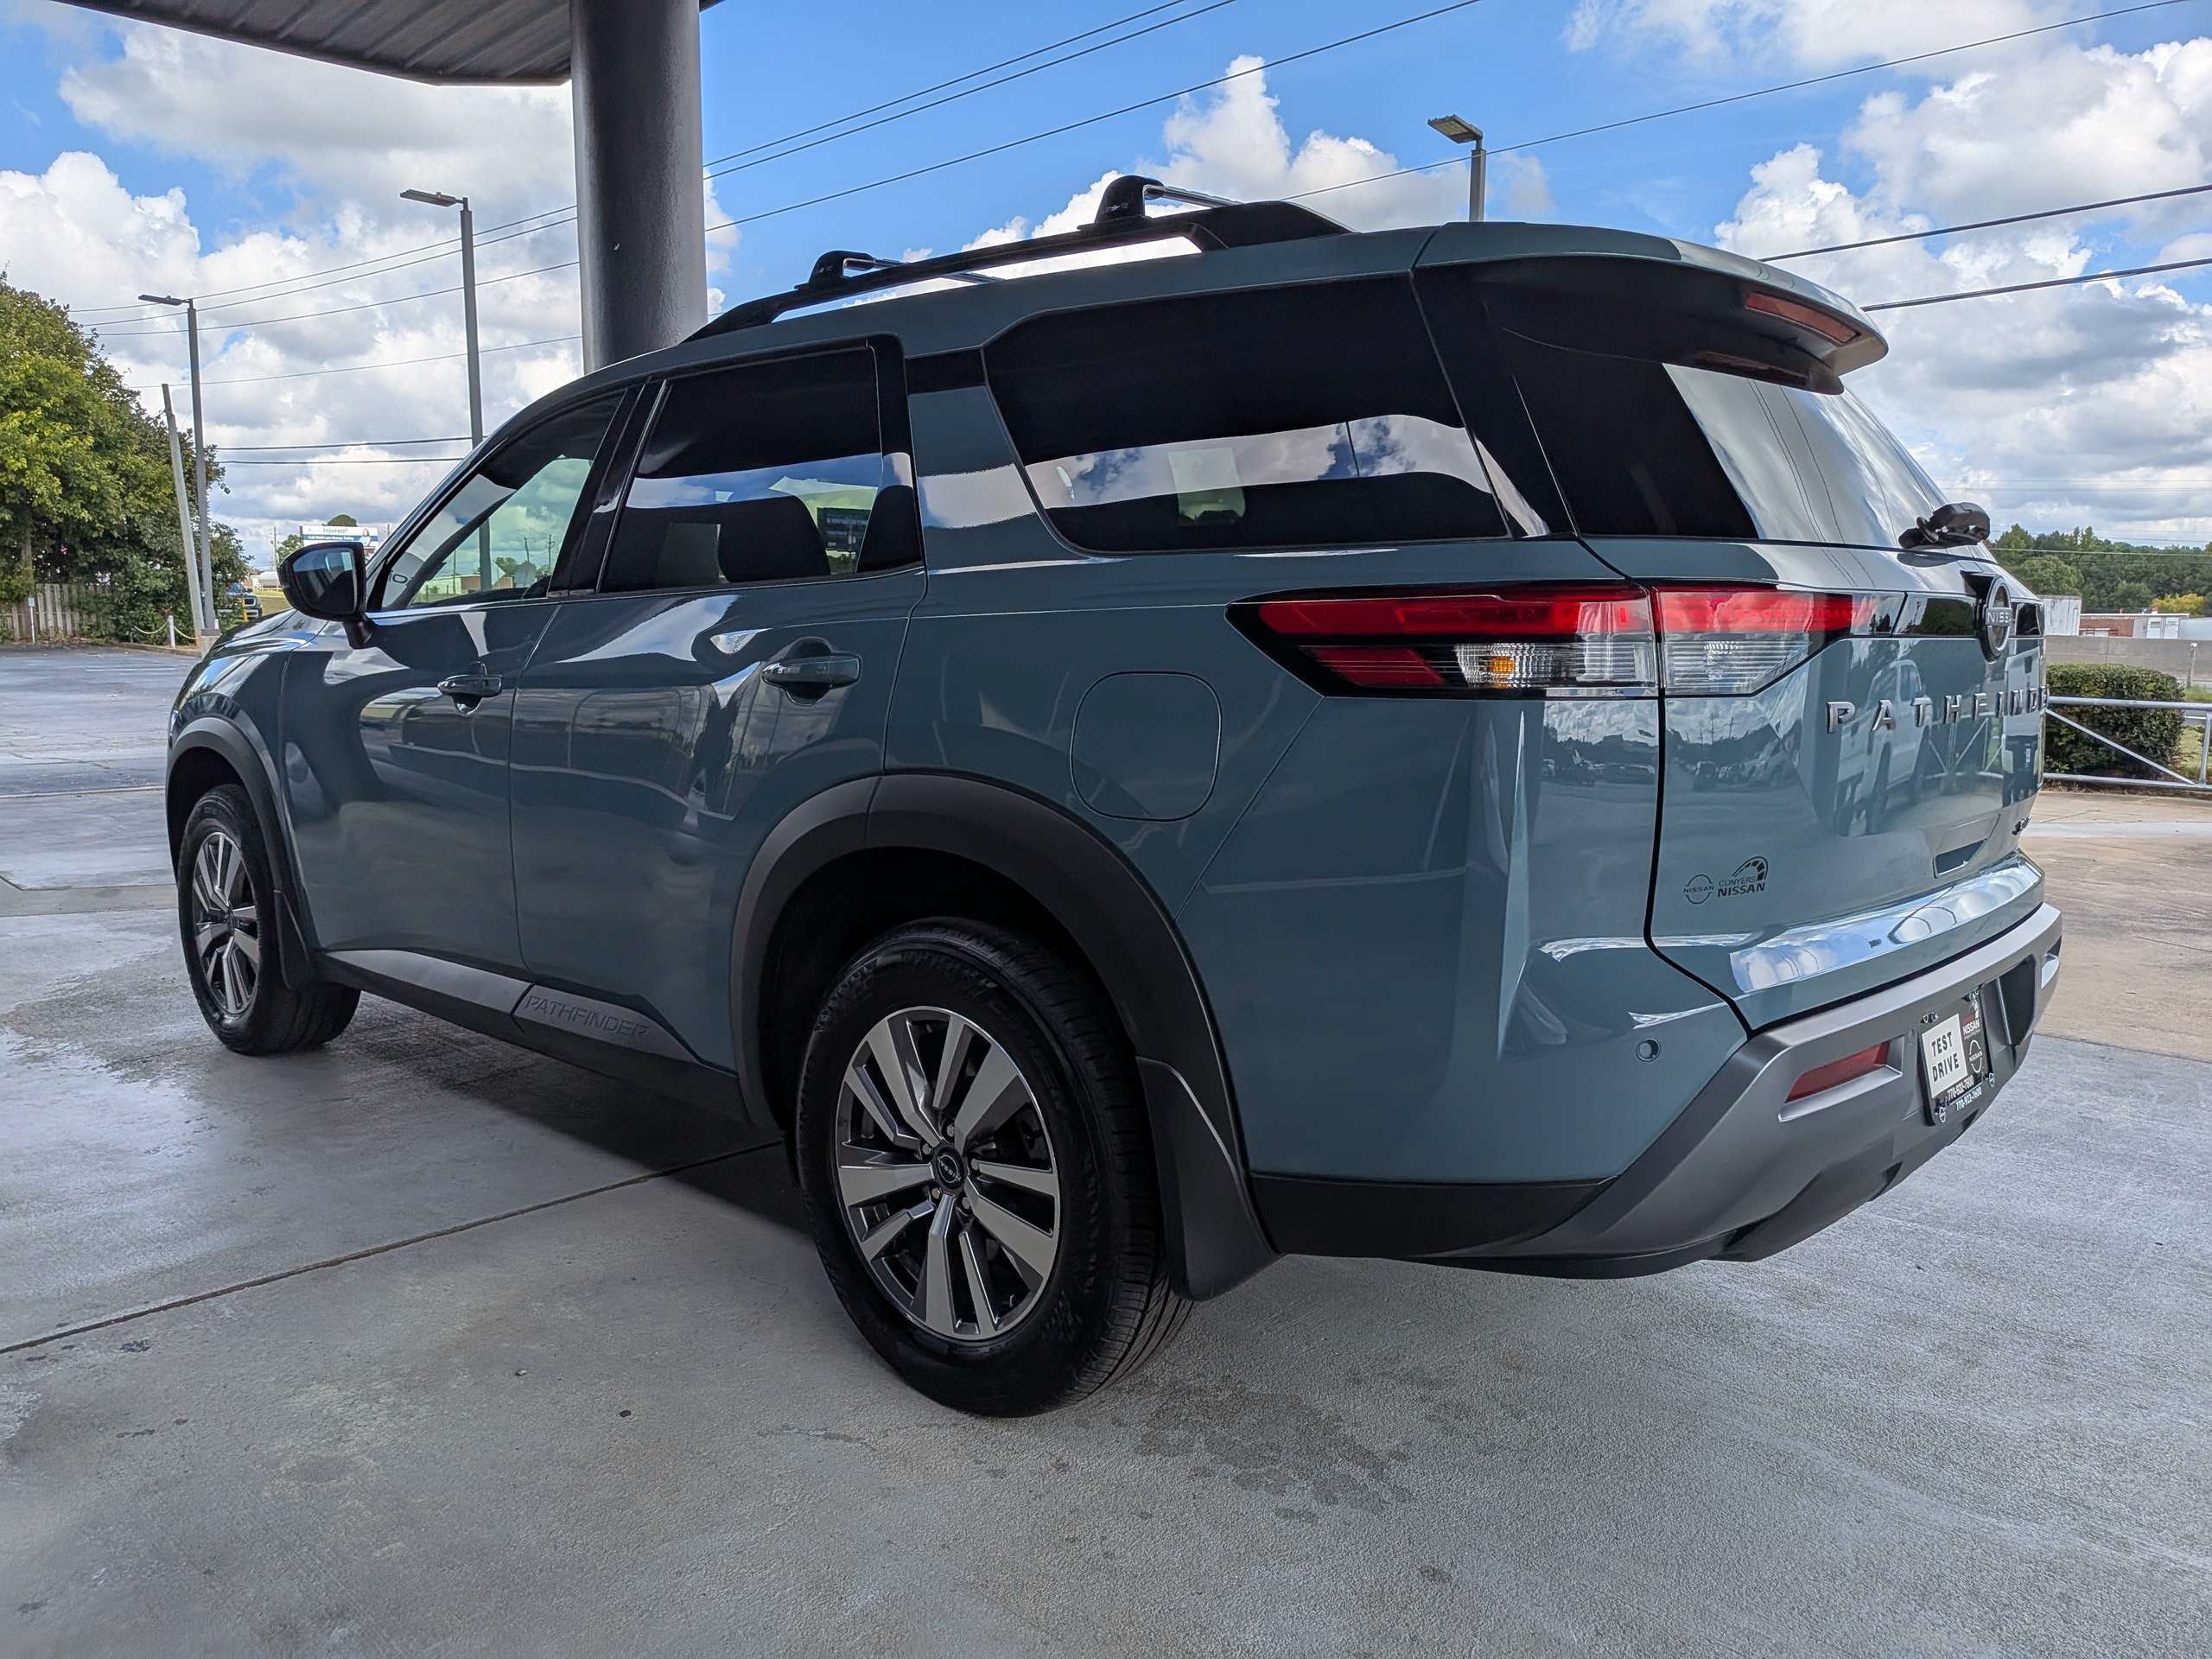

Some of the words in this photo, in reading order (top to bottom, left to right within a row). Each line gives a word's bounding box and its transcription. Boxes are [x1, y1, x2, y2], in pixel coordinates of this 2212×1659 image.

[1986, 611, 2012, 623] NISS
[1717, 882, 1765, 898] NISSAN
[1719, 876, 1757, 887] CONYERS
[524, 995, 650, 1036] PATHFINDER
[1931, 1032, 1953, 1057] TEST
[1931, 1052, 1960, 1082] DRIVE
